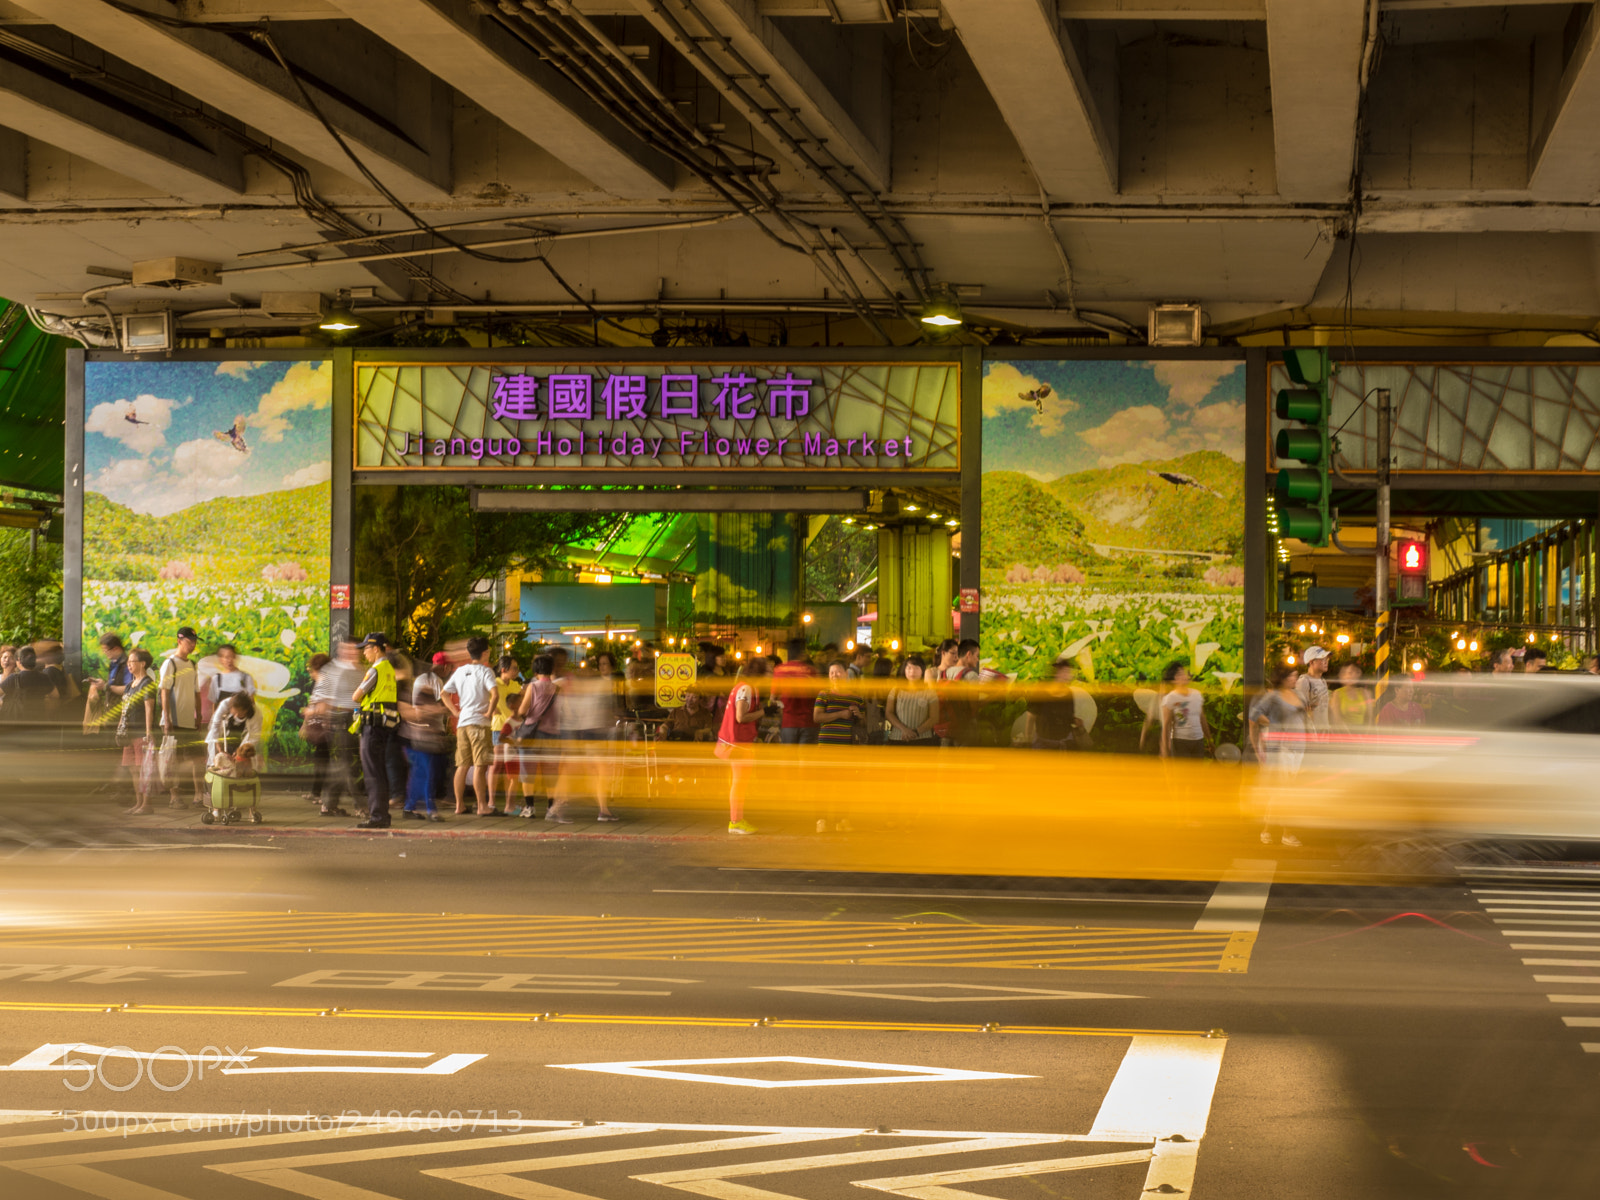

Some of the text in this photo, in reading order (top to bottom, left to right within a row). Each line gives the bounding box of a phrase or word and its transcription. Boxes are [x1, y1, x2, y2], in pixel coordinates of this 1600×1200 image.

[492, 372, 813, 421] 建國假日花市
[396, 431, 913, 460] Jianguo Holiday Flower Market
